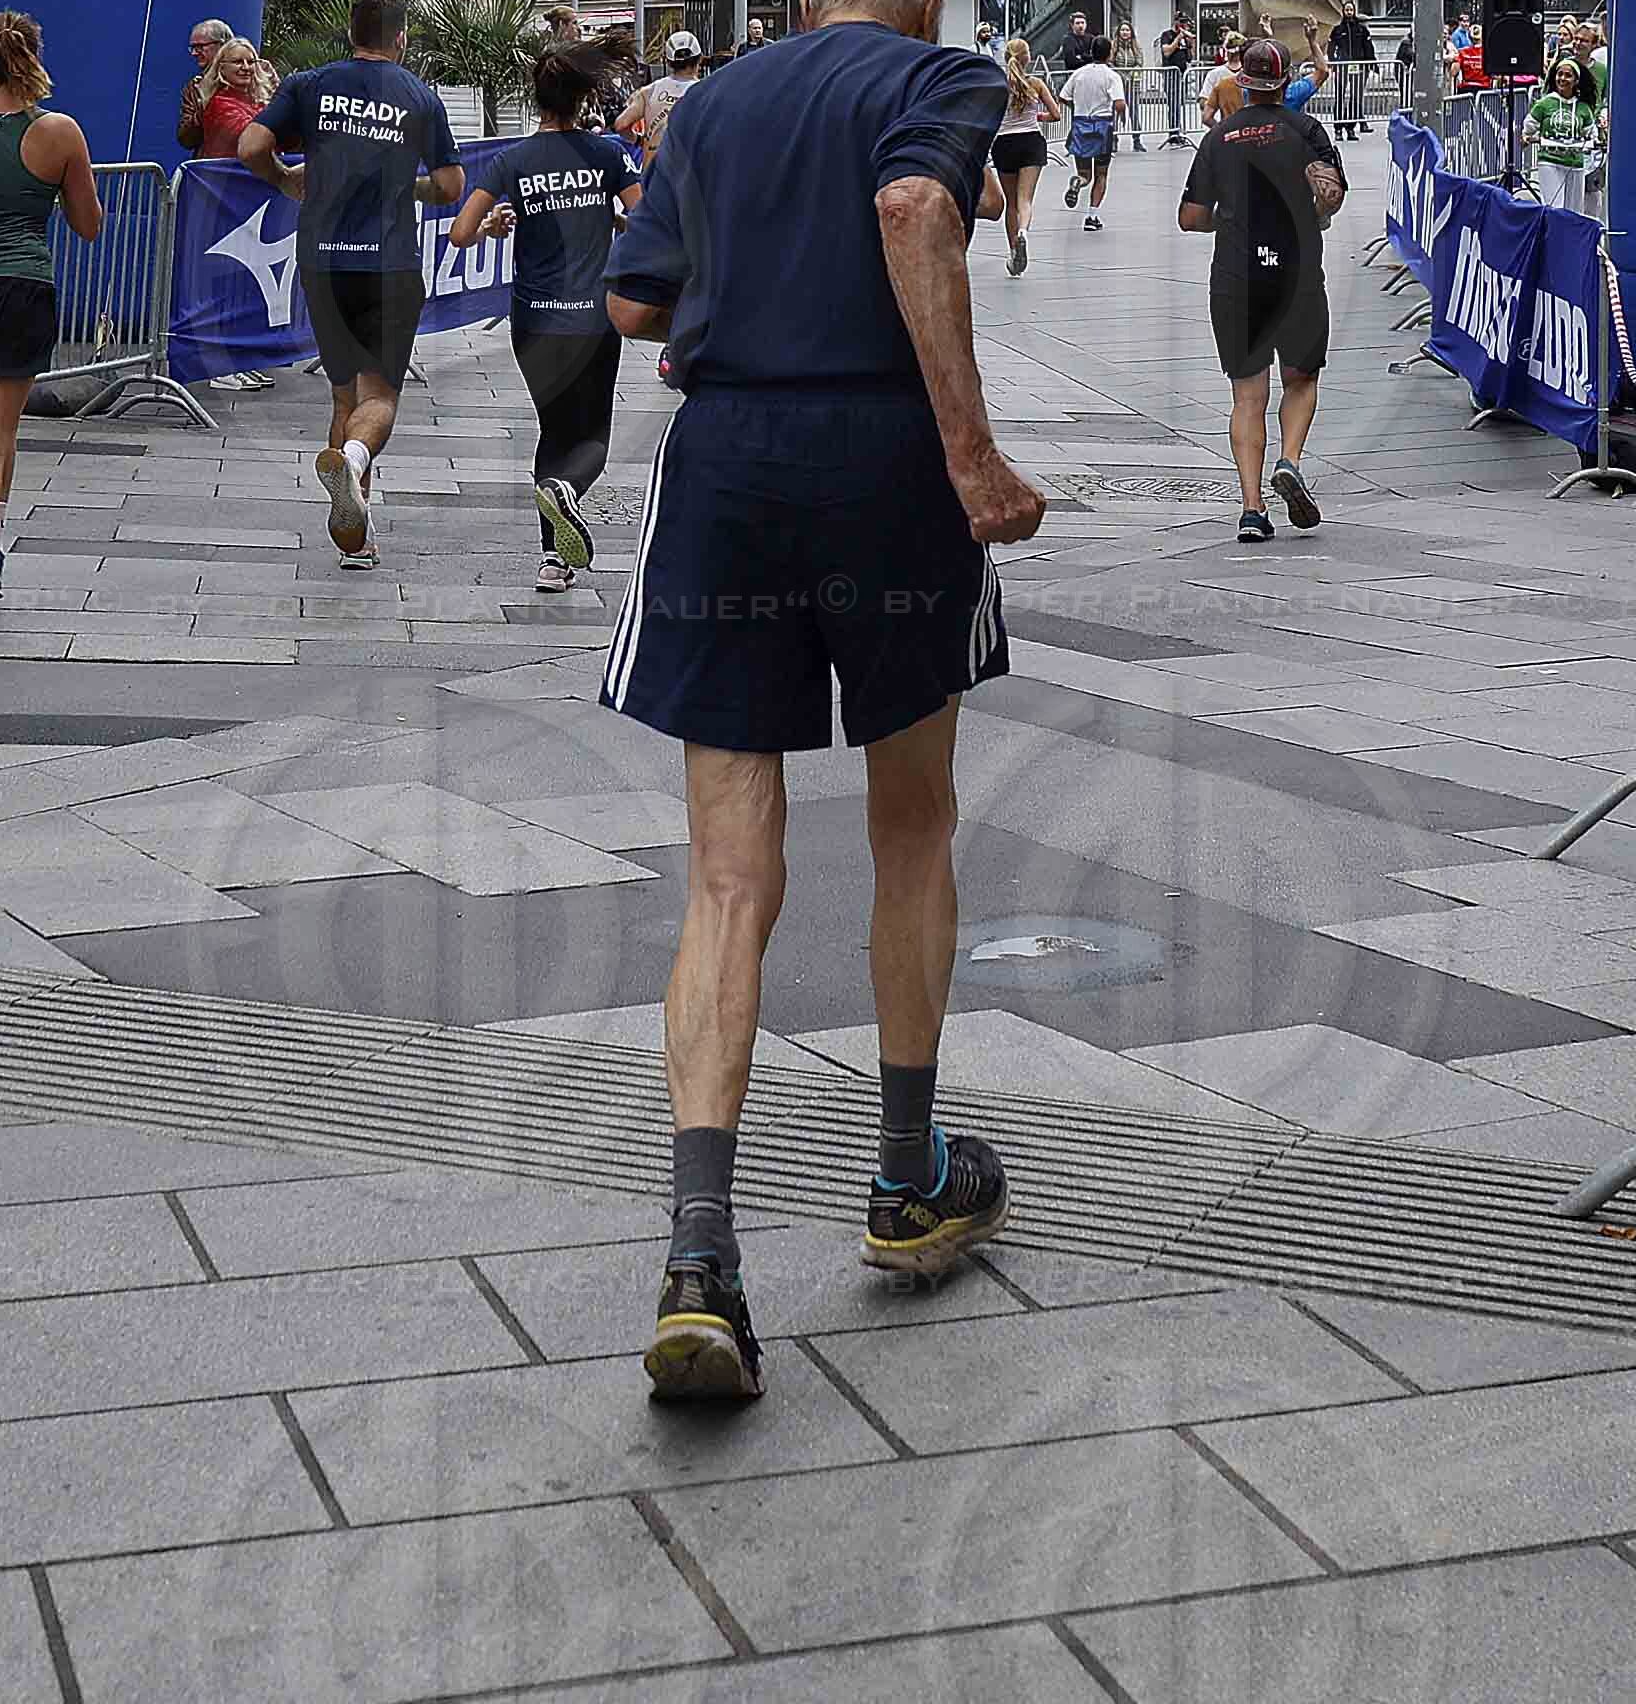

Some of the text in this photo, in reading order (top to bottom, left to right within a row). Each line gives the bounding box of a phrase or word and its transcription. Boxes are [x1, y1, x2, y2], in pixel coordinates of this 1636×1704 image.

[320, 95, 408, 126] BREADY
[318, 115, 339, 132] for
[342, 117, 368, 137] this
[1241, 124, 1276, 137] GRAZ
[519, 169, 605, 197] BREADY
[523, 192, 606, 216] for this run!
[318, 241, 379, 252] martinauer.at
[530, 298, 594, 310] martinauer.at
